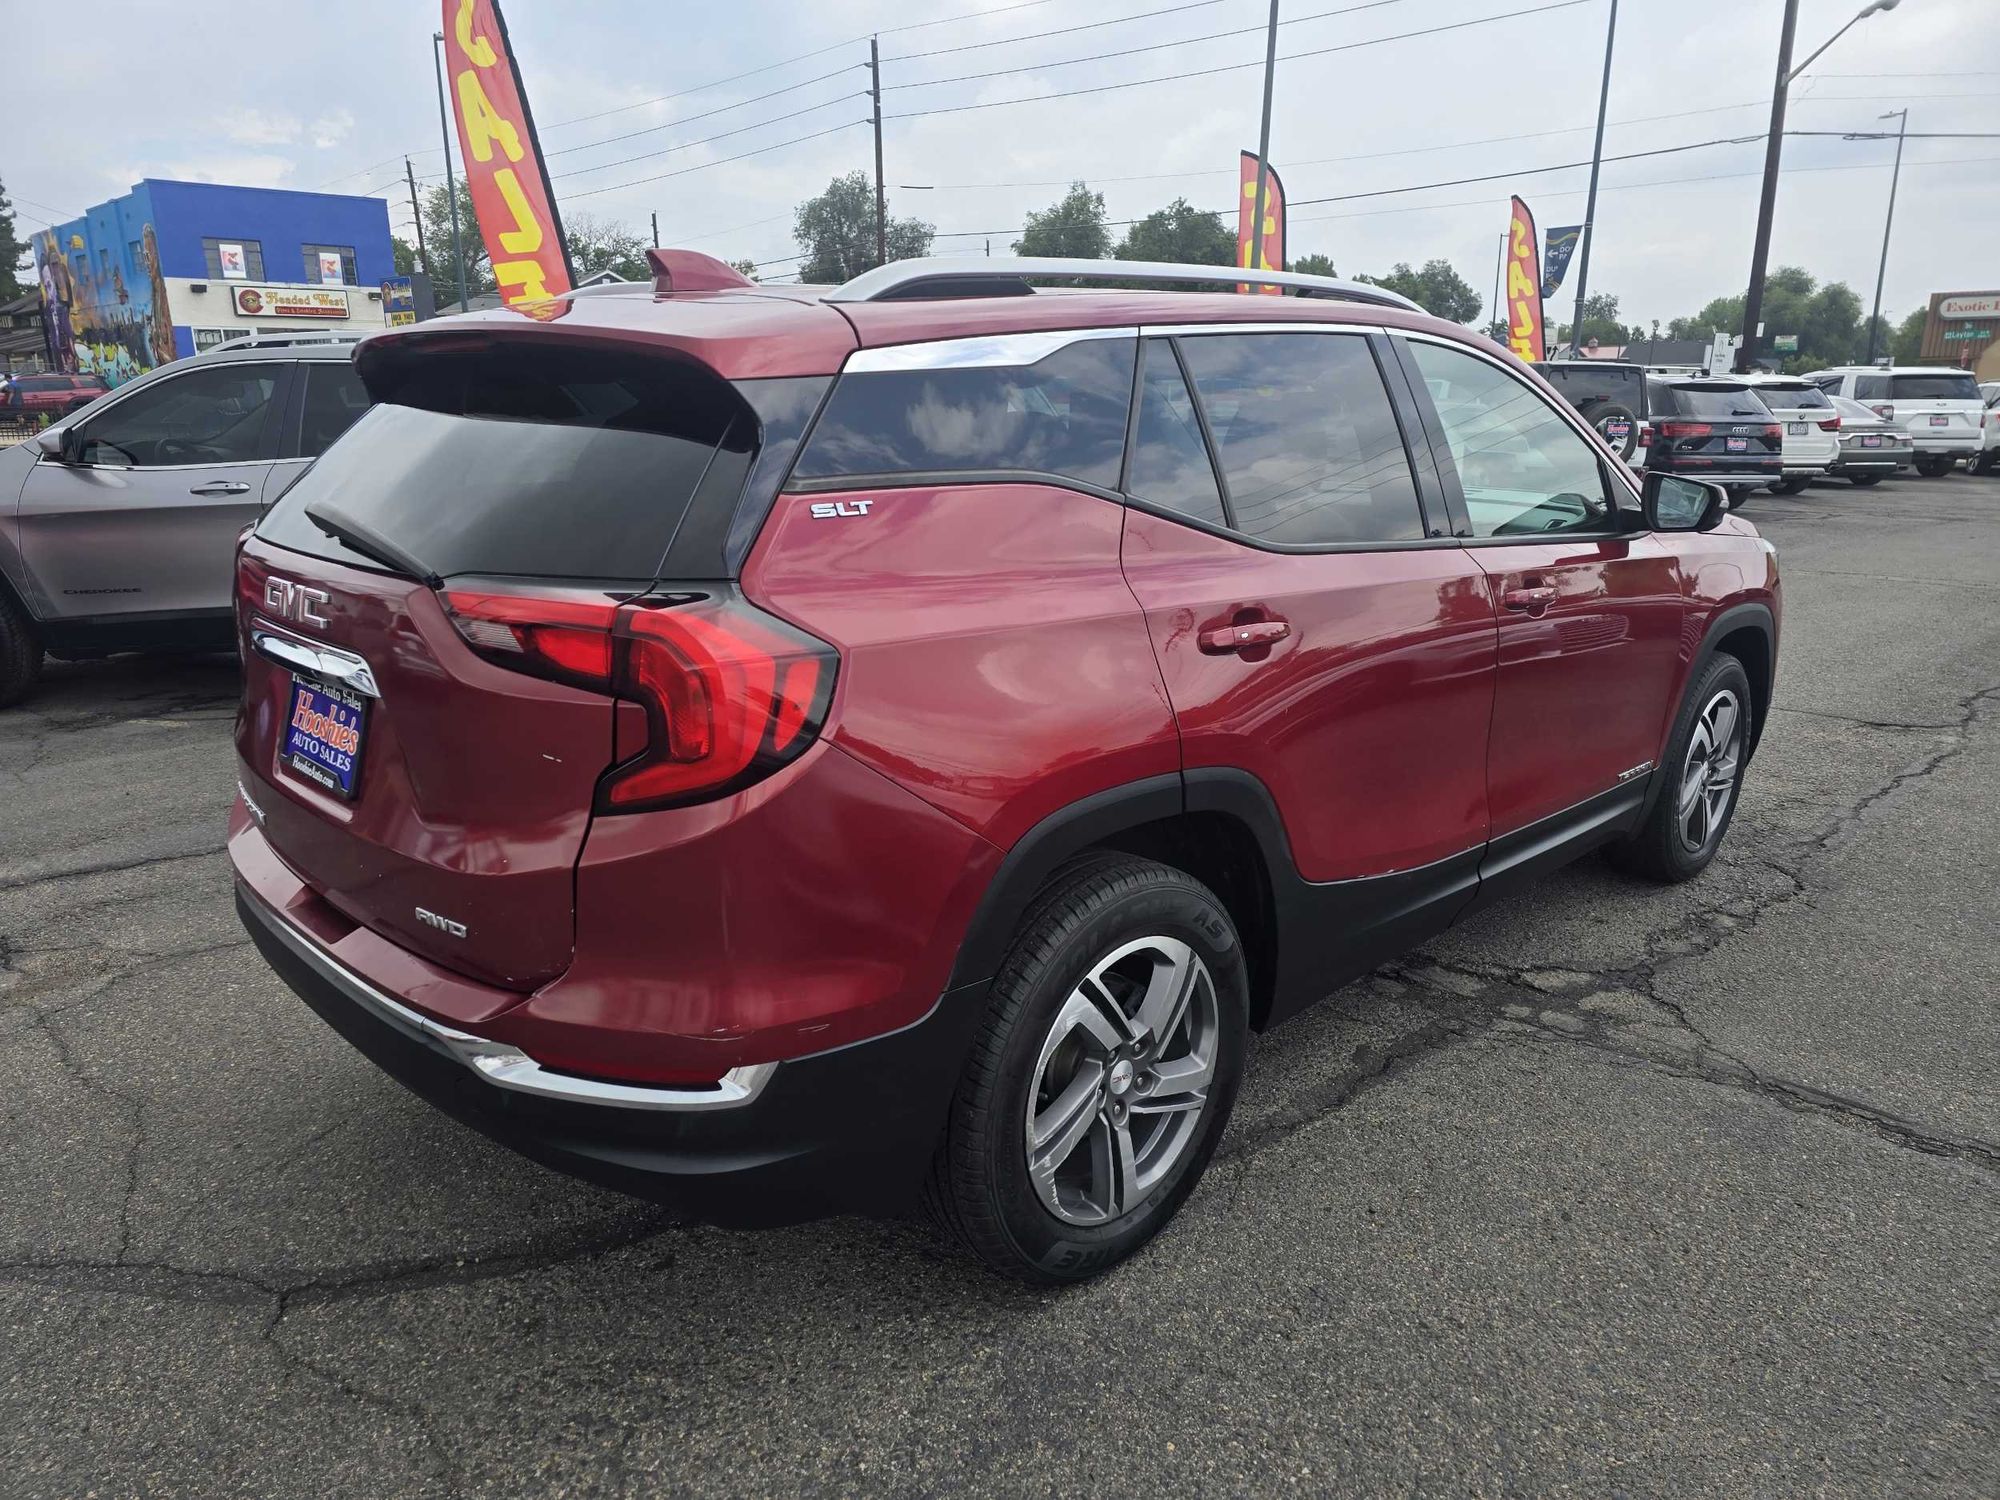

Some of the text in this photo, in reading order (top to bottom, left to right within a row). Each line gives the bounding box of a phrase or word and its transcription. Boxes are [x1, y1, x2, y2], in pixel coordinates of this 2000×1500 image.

[312, 293, 345, 306] West
[1946, 301, 1987, 312] Exotic
[810, 500, 873, 518] SLT
[264, 575, 332, 629] GMC
[322, 684, 362, 712] Auto Sales
[291, 689, 360, 756] Hooshie's
[291, 731, 352, 772] AUTO SALES
[415, 906, 467, 938] AWD
